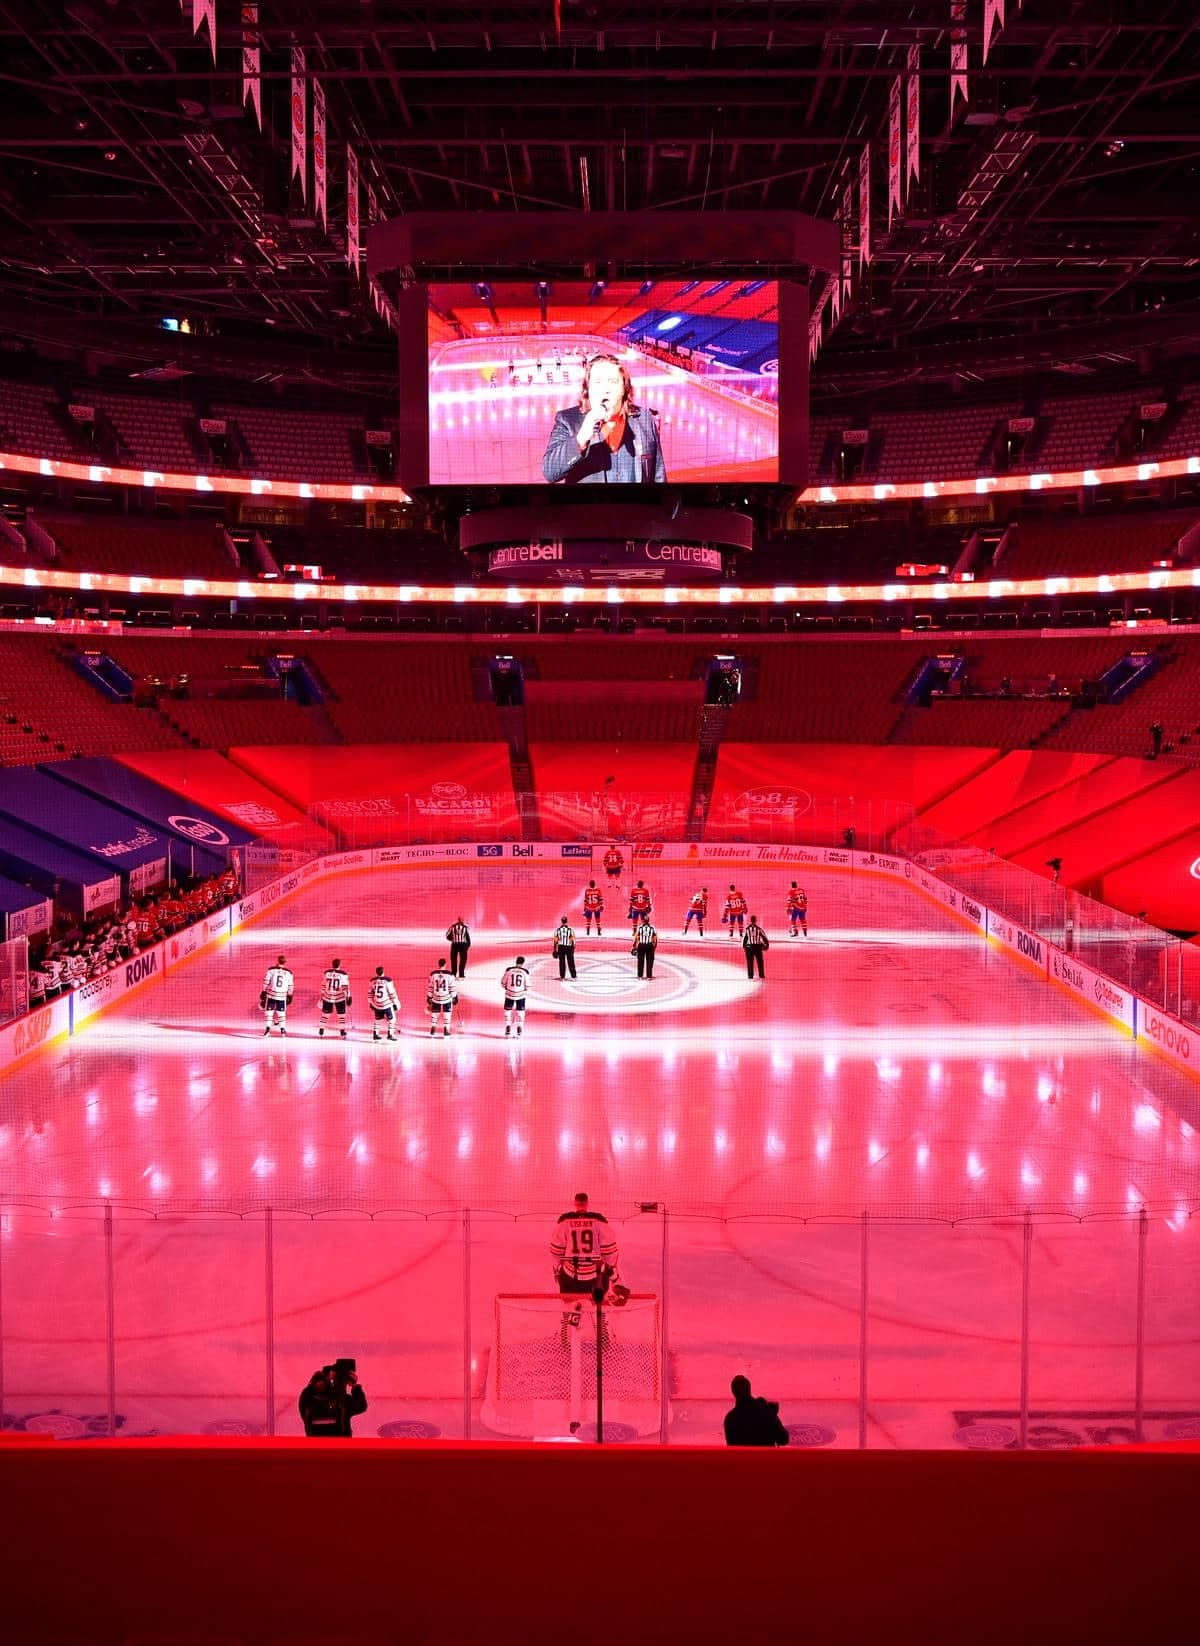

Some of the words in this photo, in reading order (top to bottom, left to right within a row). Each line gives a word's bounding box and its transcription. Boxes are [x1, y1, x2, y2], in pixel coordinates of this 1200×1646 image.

[415, 798, 491, 809] BACARDI
[482, 846, 497, 856] 5G
[512, 845, 534, 857] Bell
[563, 846, 592, 856] Lafleur
[756, 846, 777, 860] Tim
[778, 847, 819, 863] Hortons
[260, 882, 281, 907] RICOH
[1017, 931, 1042, 964] RONA
[126, 952, 158, 988] RONA
[275, 975, 283, 987] 6
[326, 978, 340, 992] 70
[434, 979, 446, 992] 14
[510, 974, 522, 987] 16
[1144, 1007, 1190, 1059] Lenovo
[571, 1229, 593, 1254] 19
